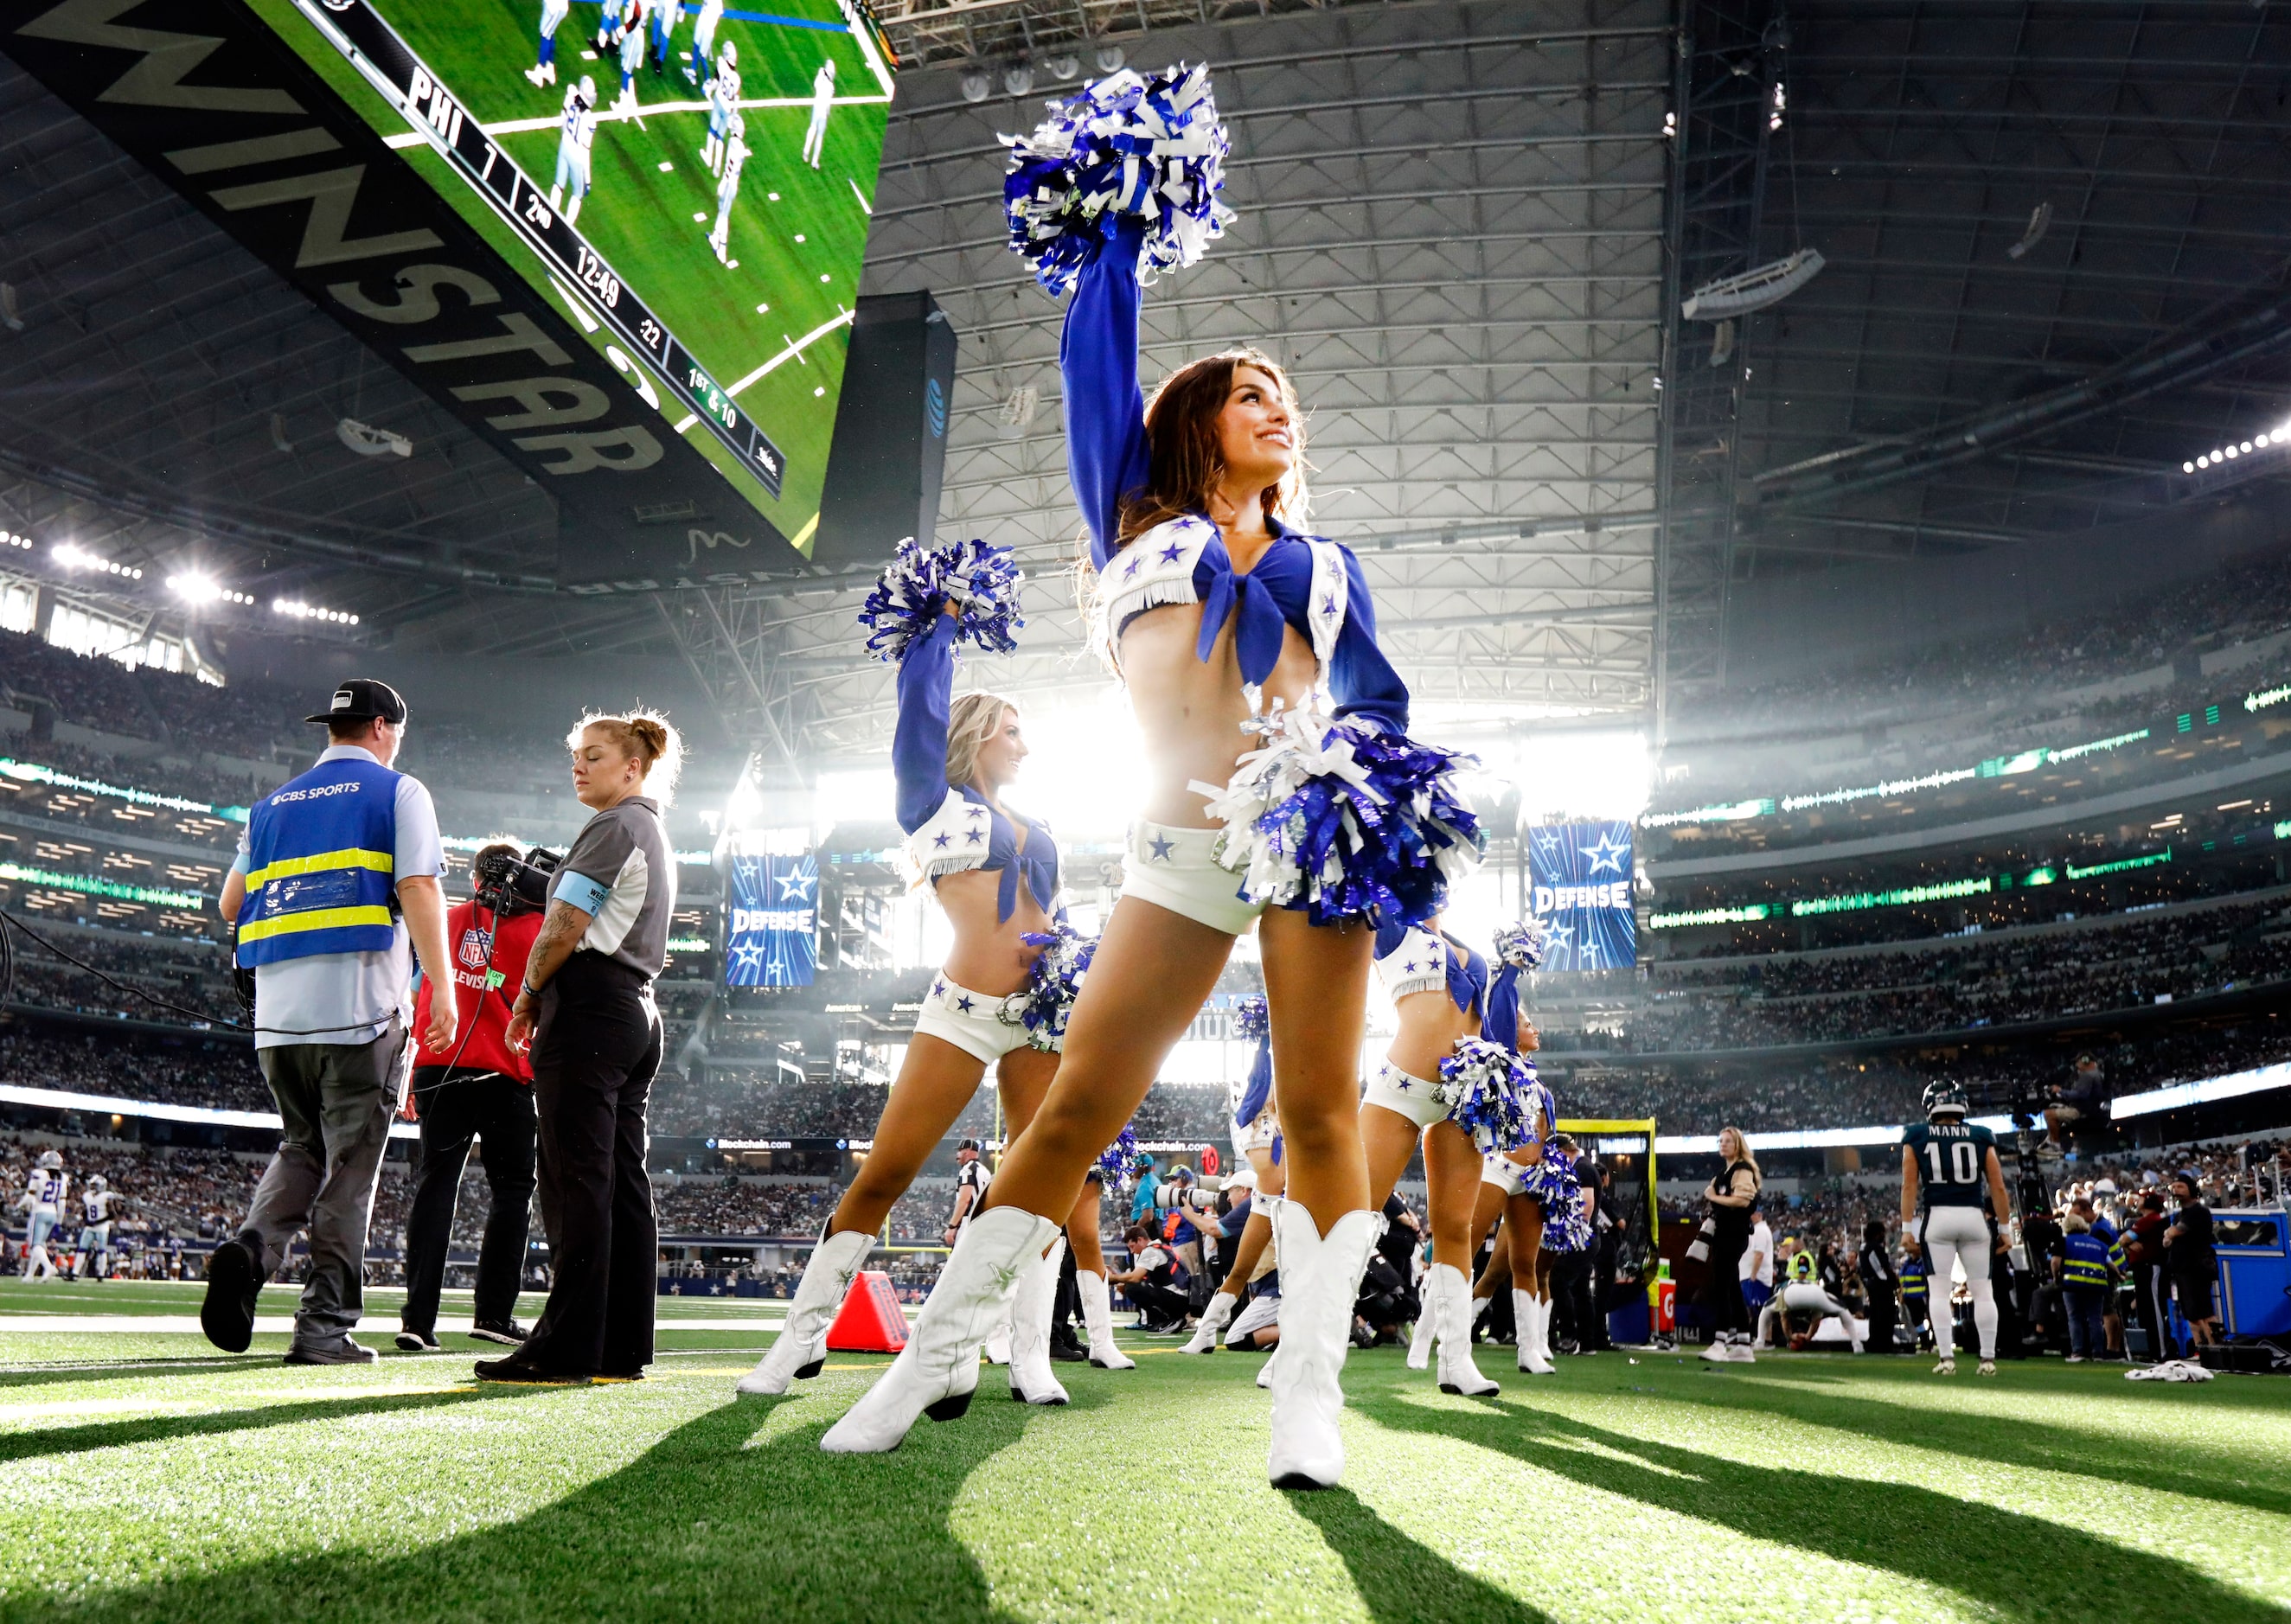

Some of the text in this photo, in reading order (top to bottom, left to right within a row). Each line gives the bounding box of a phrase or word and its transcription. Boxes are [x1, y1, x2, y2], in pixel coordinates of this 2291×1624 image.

[13, 0, 664, 476] WINSTAR
[408, 65, 464, 149] PHI
[481, 142, 498, 181] 7
[525, 194, 552, 230] 2ND
[577, 246, 619, 309] 12:49
[689, 368, 709, 392] 1ST
[708, 389, 718, 412] &
[721, 403, 736, 428] 10
[280, 782, 361, 802] CBS SPORTS
[1534, 881, 1631, 914] DEFENSE
[732, 909, 815, 933] DEFENSE
[463, 943, 486, 962] NFL
[824, 1003, 862, 1013] American
[1929, 1125, 1970, 1137] MANN
[718, 1138, 791, 1149] Blockchain.com
[1136, 1141, 1212, 1152] lockchain.com
[1923, 1141, 1978, 1184] 10
[1664, 1291, 1674, 1319] G
